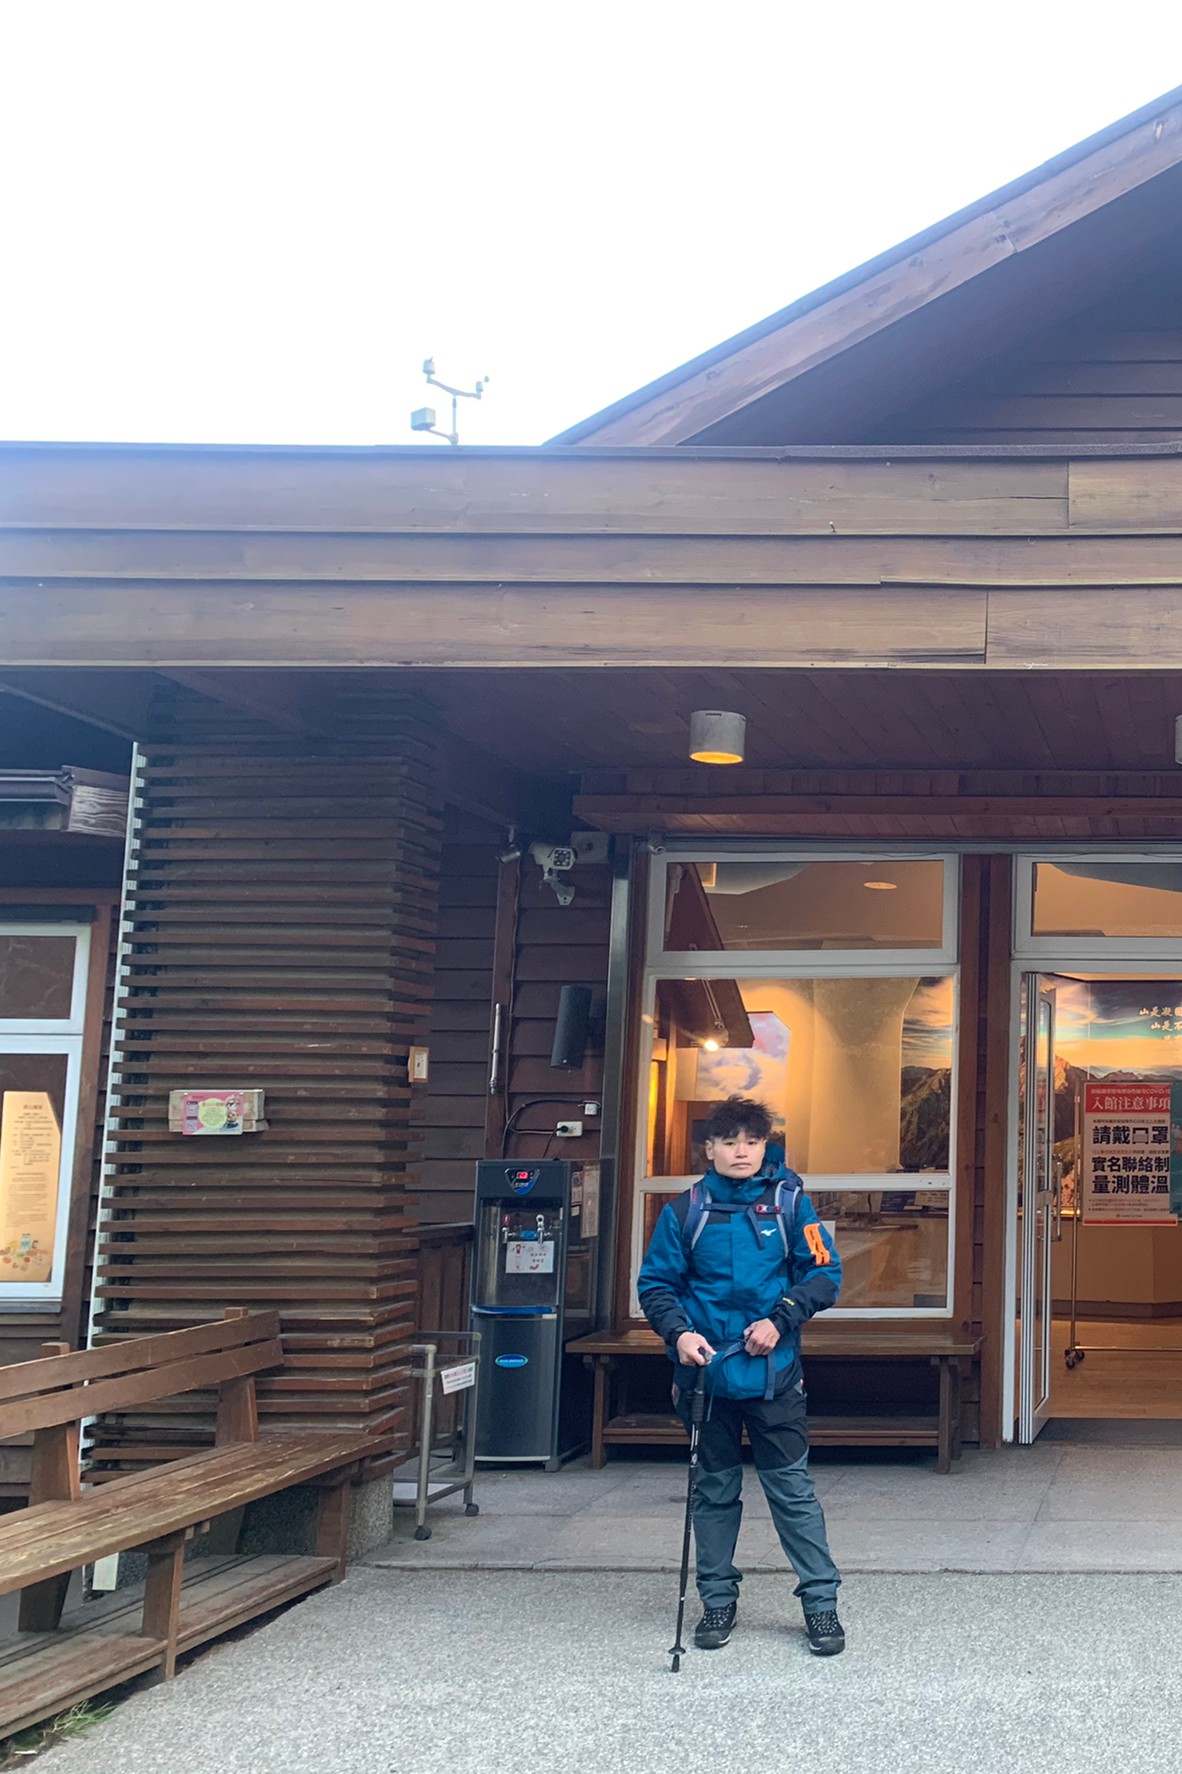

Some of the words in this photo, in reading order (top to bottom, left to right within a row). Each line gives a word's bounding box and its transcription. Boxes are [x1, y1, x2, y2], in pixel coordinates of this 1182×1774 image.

[1092, 1096, 1171, 1110] 入館注意事項
[1092, 1125, 1169, 1145] 請戴口罩
[1092, 1156, 1170, 1172] 實名聯絡制
[1092, 1174, 1170, 1194] 量測體溫
